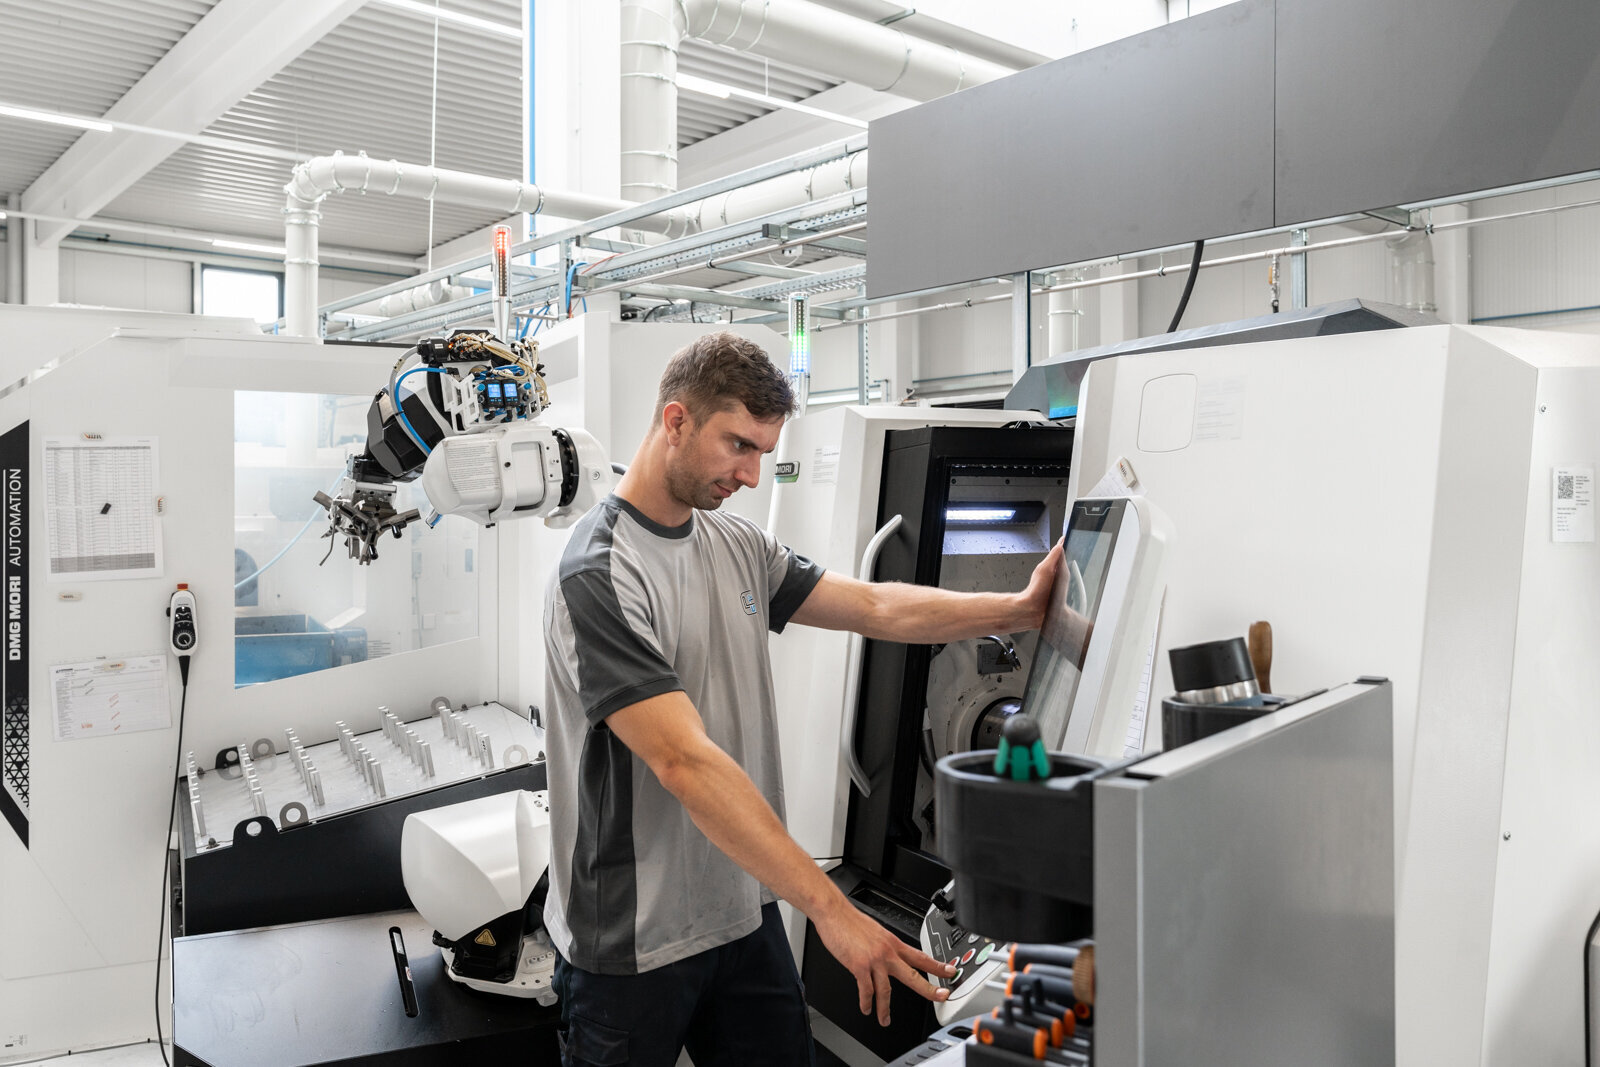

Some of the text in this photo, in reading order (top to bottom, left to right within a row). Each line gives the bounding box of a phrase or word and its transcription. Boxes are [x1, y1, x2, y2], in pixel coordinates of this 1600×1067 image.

[9, 468, 22, 661] DMG MORI AUTOMATION
